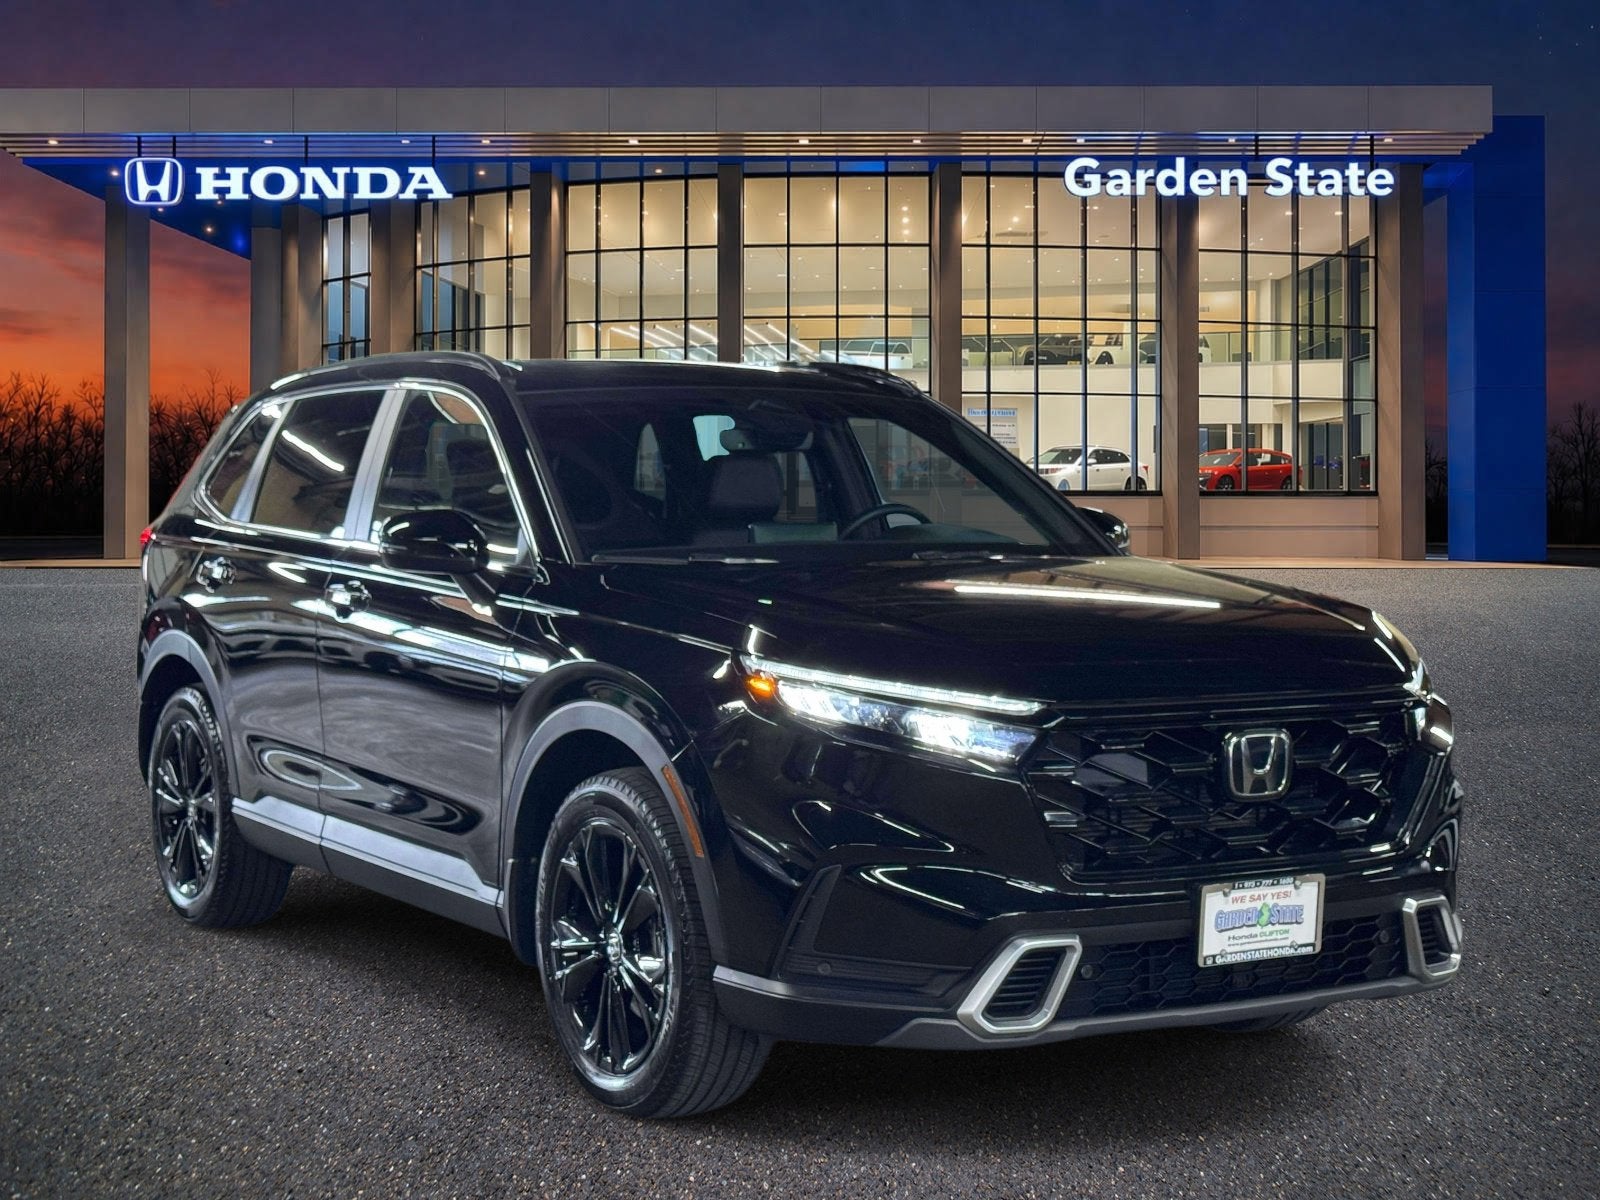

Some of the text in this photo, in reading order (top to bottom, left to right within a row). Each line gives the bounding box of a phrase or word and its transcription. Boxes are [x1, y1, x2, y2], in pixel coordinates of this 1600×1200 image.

[195, 166, 453, 200] HONDA
[1063, 156, 1395, 198] Garden State
[1232, 891, 1292, 904] WE SAY YES!
[1228, 928, 1290, 941] Honda CLIFTON
